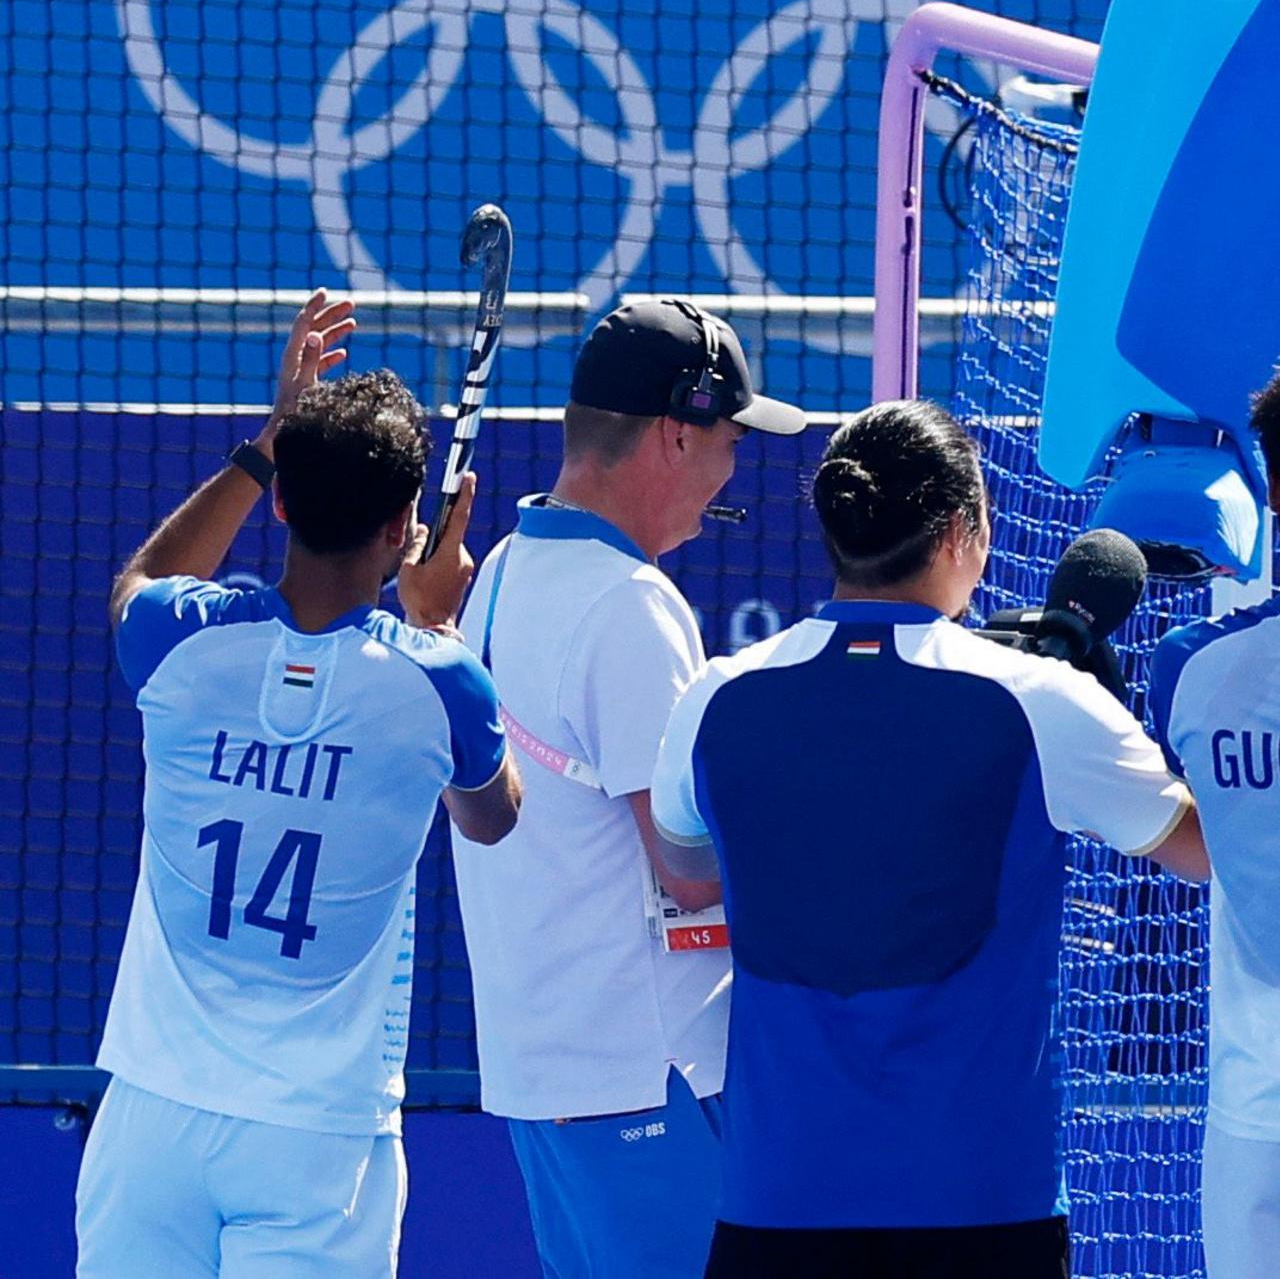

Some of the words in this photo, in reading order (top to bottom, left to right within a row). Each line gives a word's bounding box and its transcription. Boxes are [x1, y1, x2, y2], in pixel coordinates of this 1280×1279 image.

[208, 729, 354, 801] LALIT
[196, 818, 323, 961] 14
[645, 1121, 666, 1138] OBS
